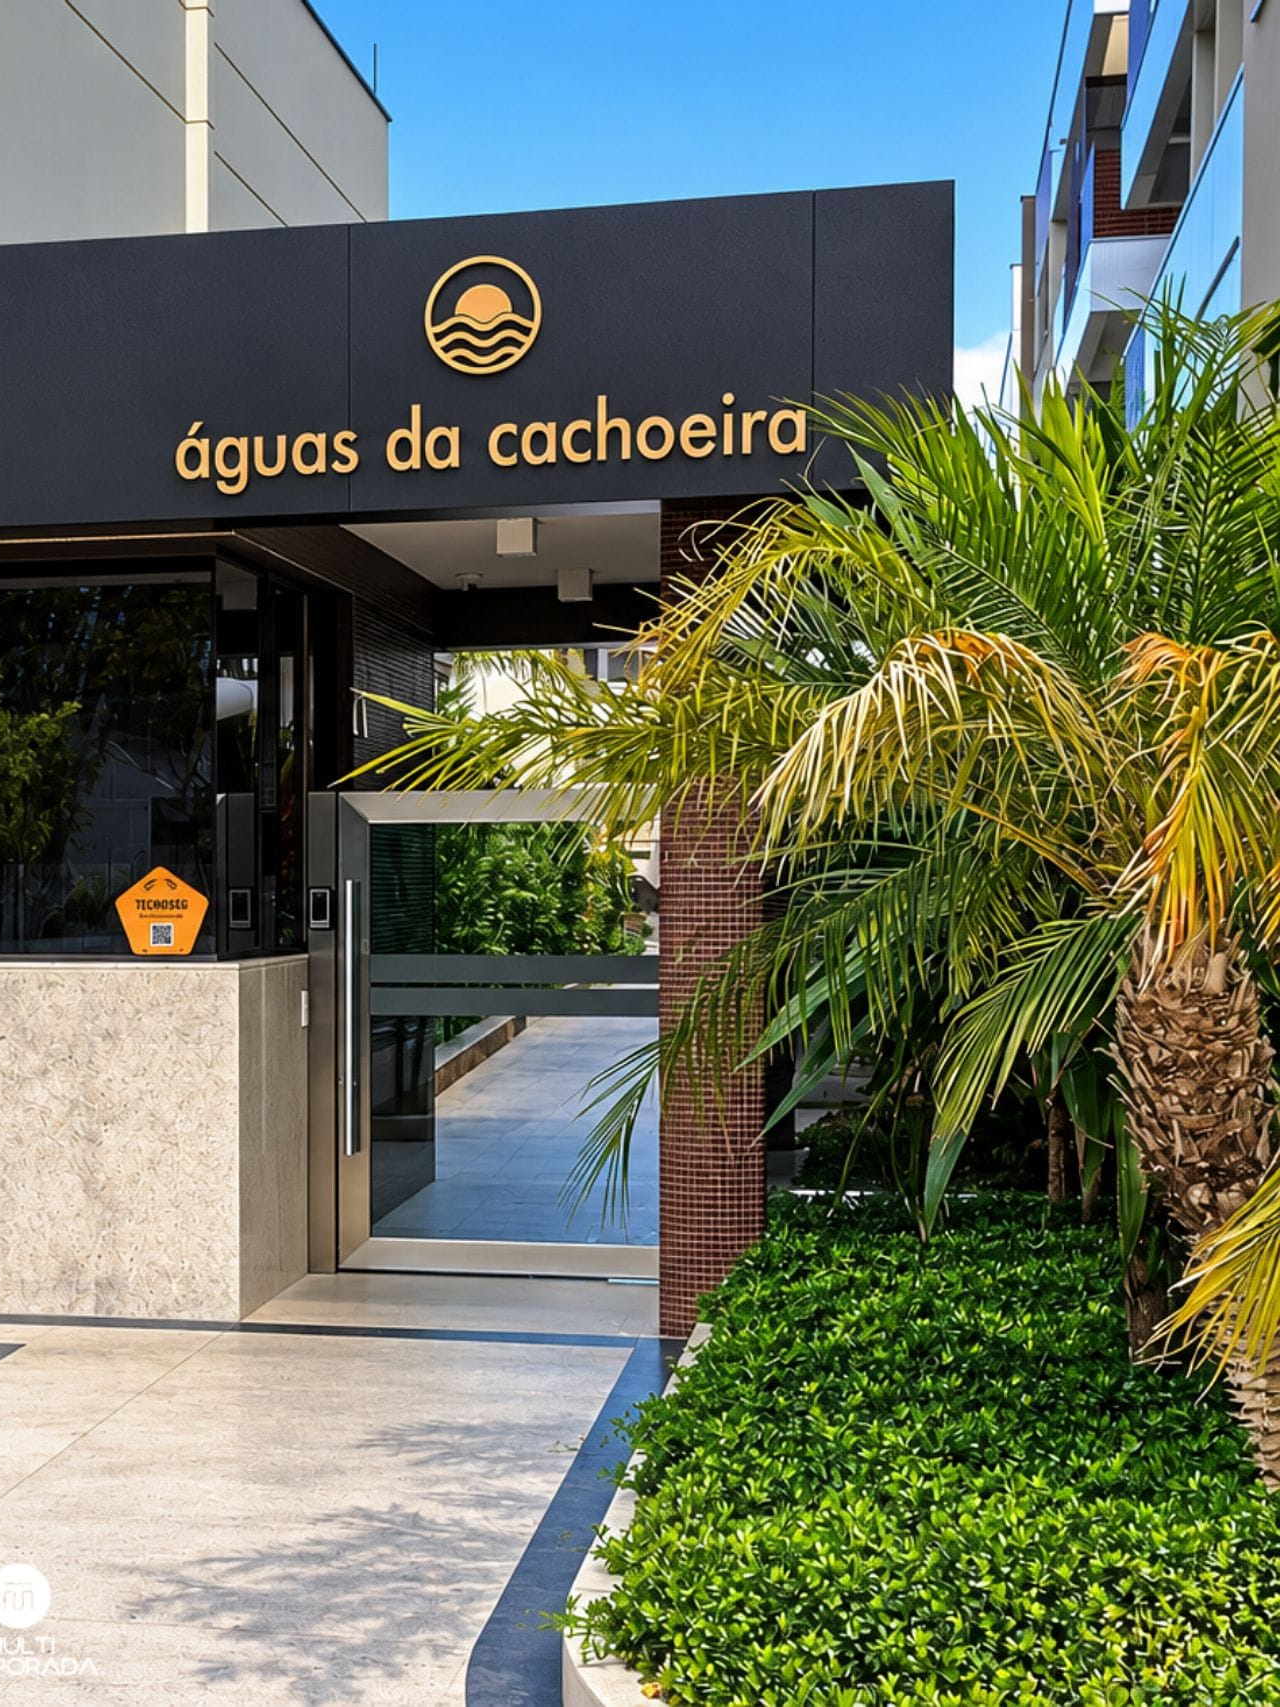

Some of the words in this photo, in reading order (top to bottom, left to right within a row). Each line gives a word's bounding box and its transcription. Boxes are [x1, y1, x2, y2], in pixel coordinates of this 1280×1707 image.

[175, 421, 360, 494] águas
[385, 403, 461, 471] da
[487, 392, 808, 468] cachoeira
